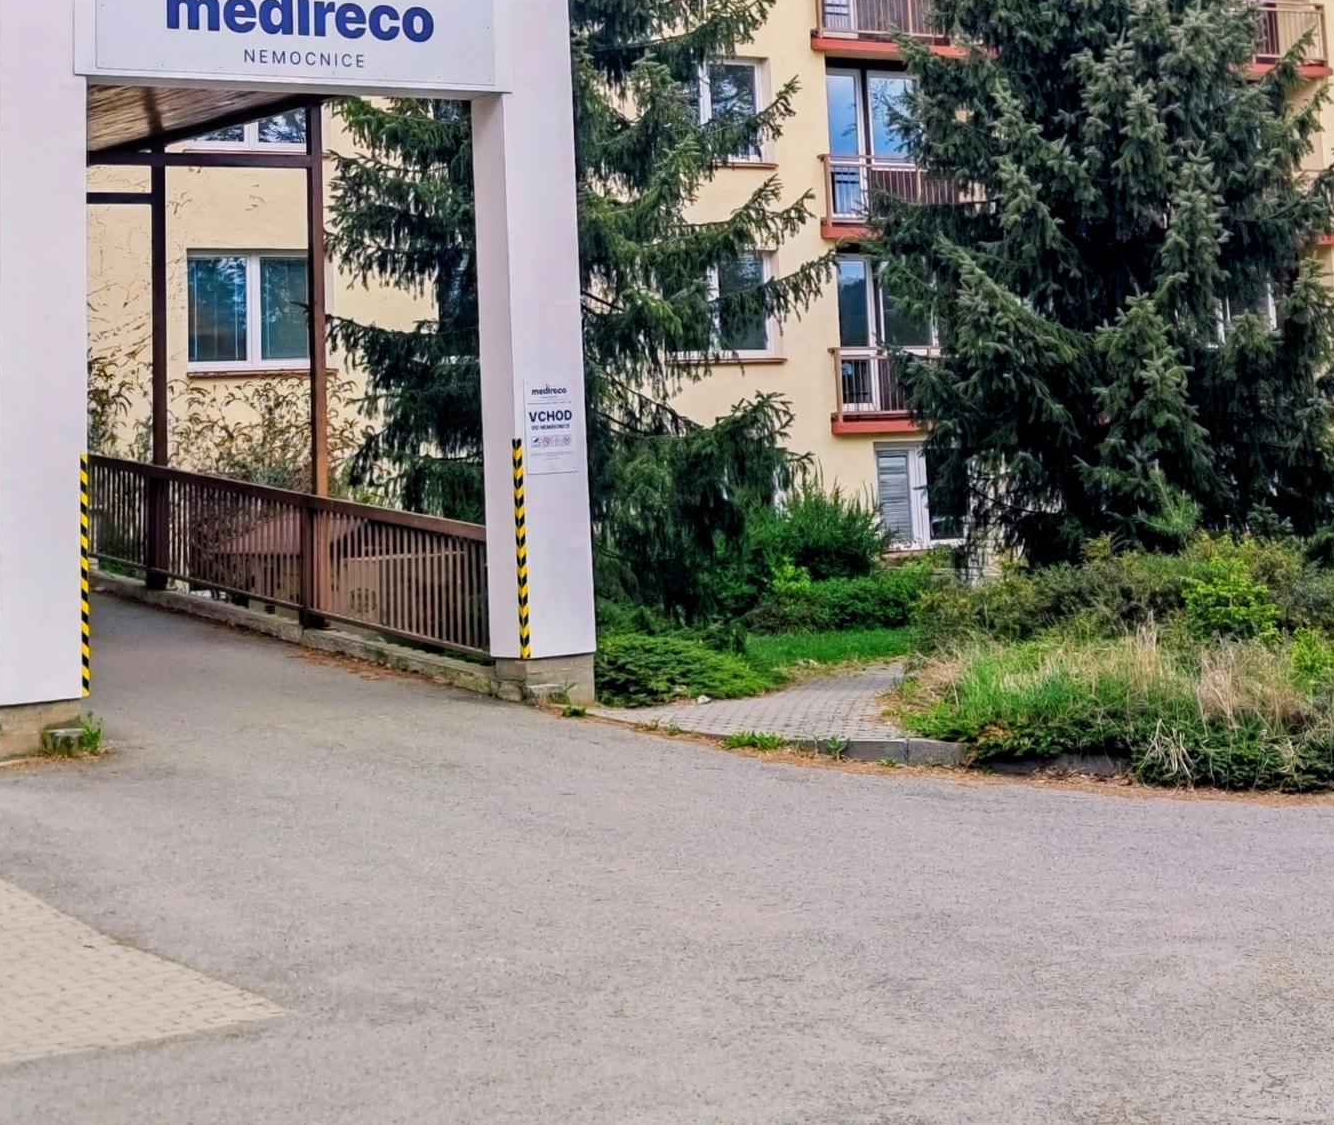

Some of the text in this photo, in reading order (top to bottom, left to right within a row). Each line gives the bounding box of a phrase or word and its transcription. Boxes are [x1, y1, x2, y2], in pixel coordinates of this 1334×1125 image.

[243, 48, 365, 68] NEMOCNICE
[531, 384, 567, 395] medireco
[529, 410, 572, 422] VCHOD
